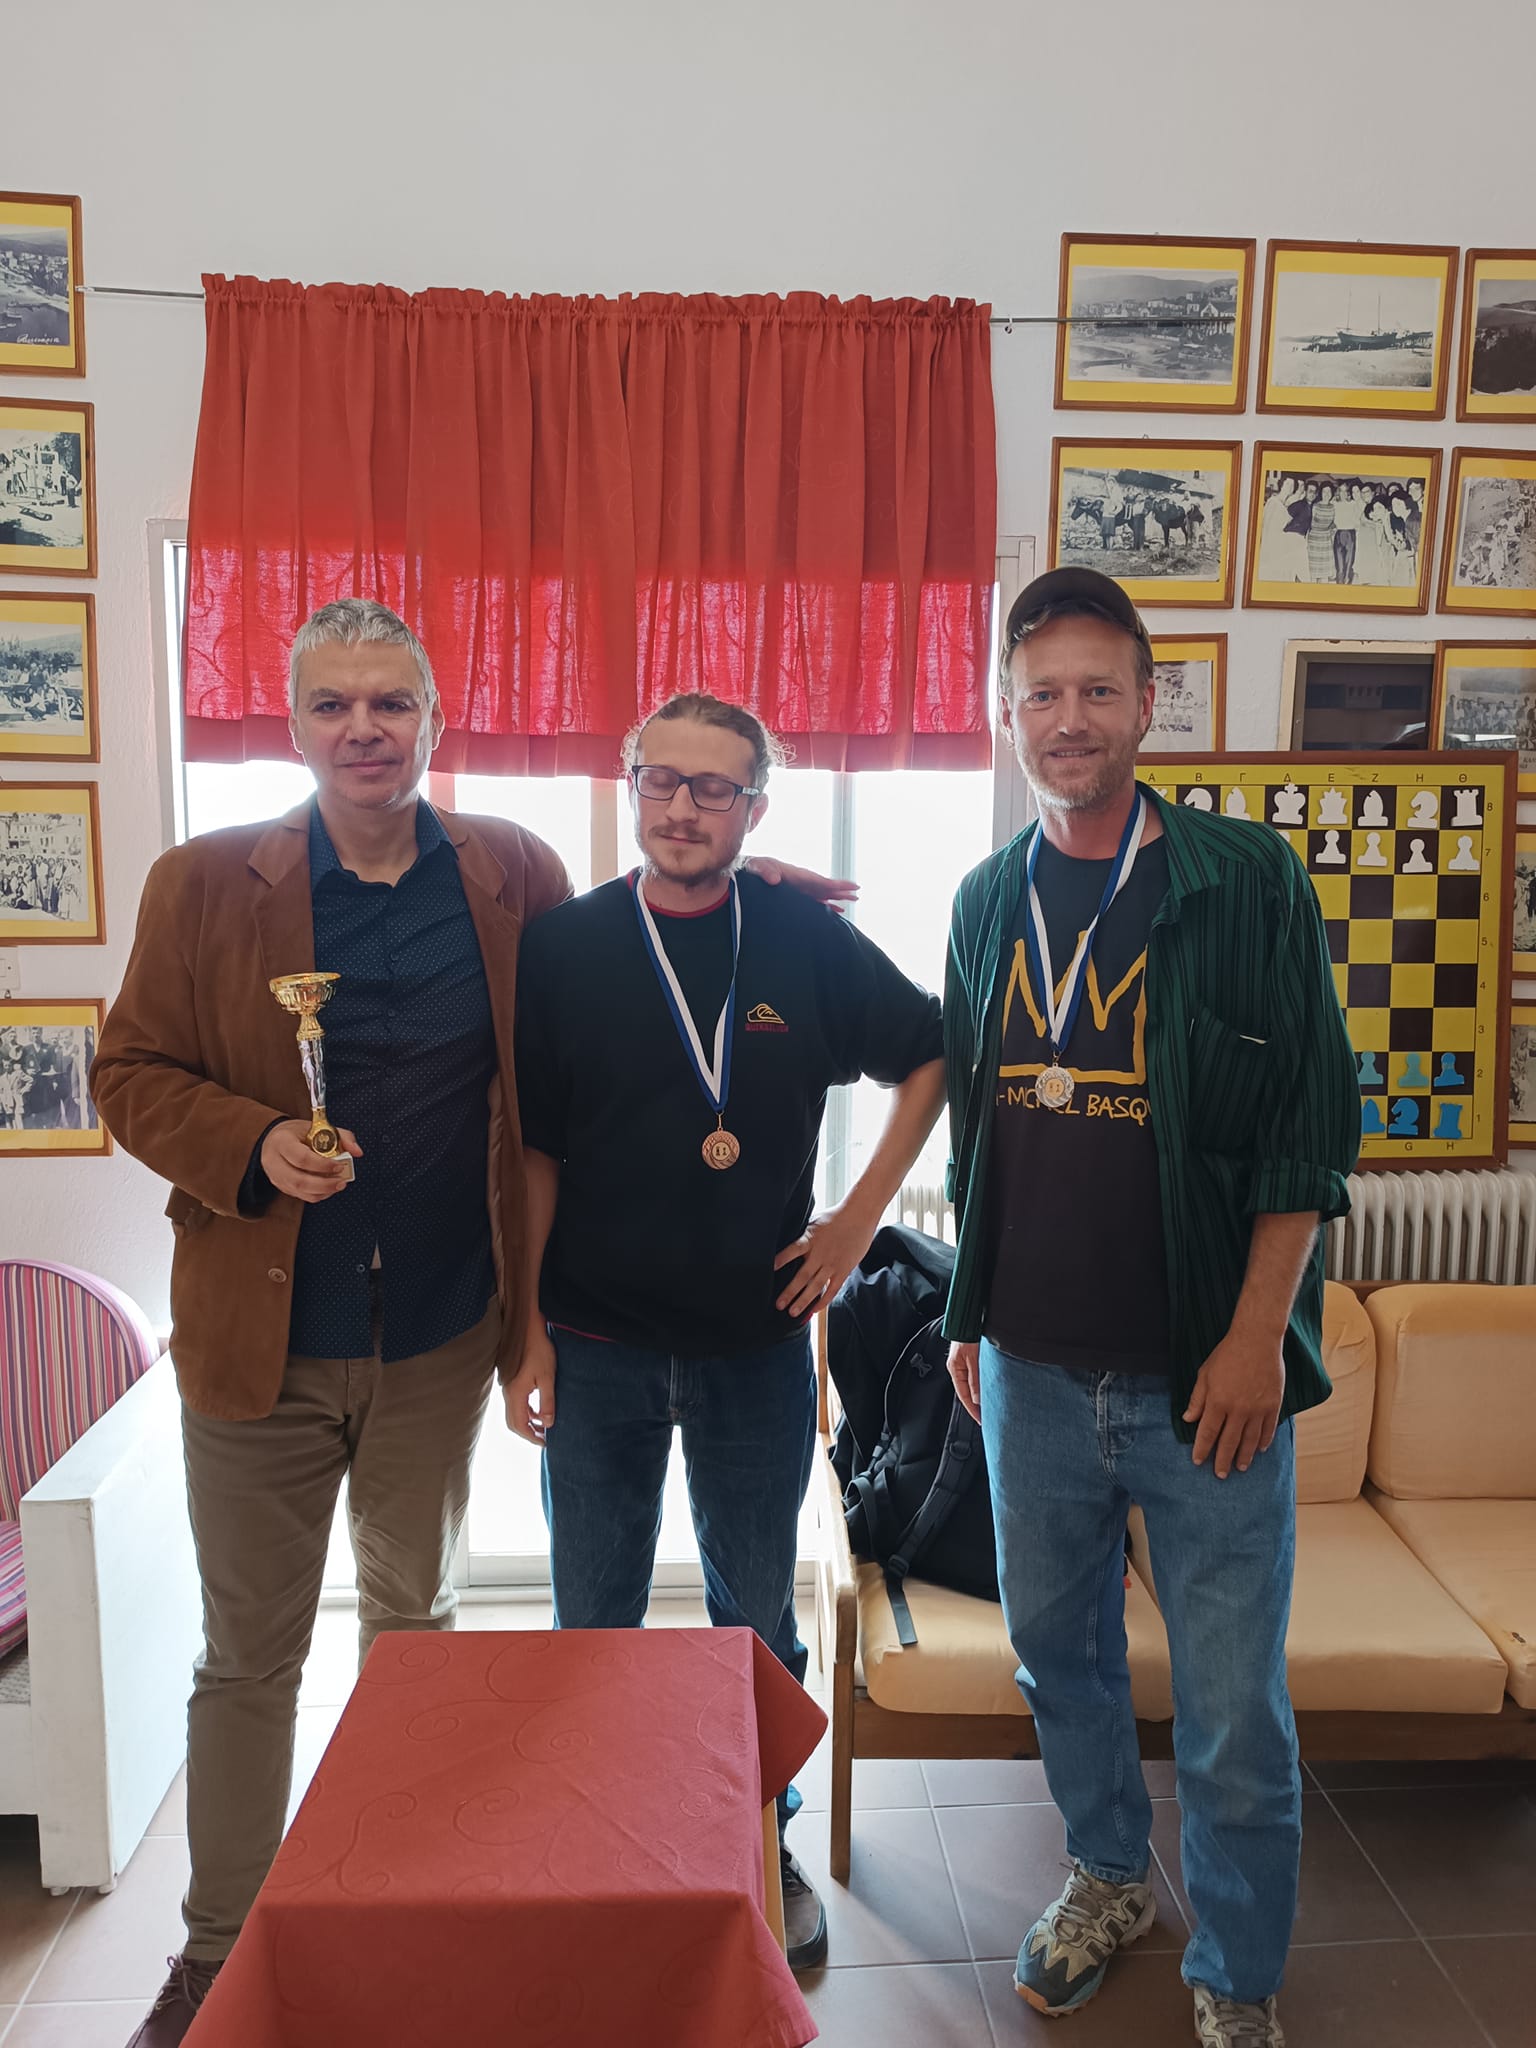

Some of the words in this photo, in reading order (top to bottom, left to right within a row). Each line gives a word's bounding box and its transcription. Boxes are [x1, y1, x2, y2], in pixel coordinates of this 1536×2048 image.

[1147, 772, 1156, 782] Α
[1195, 772, 1203, 782] Β
[1239, 772, 1247, 782] Γ
[1283, 772, 1292, 783] Δ
[1327, 773, 1336, 783] Ε
[1371, 773, 1379, 783] Ζ
[1415, 773, 1424, 783] Η
[1458, 773, 1468, 783] Θ
[1486, 802, 1493, 811] 8
[1485, 848, 1491, 857] 7
[1483, 892, 1490, 902] 6
[1481, 936, 1488, 946] 5
[1479, 981, 1486, 990] 4
[1478, 1025, 1485, 1034] 3
[1476, 1069, 1484, 1078] 2
[1361, 1142, 1368, 1151] F
[1404, 1142, 1413, 1151] G
[1446, 1141, 1454, 1151] H
